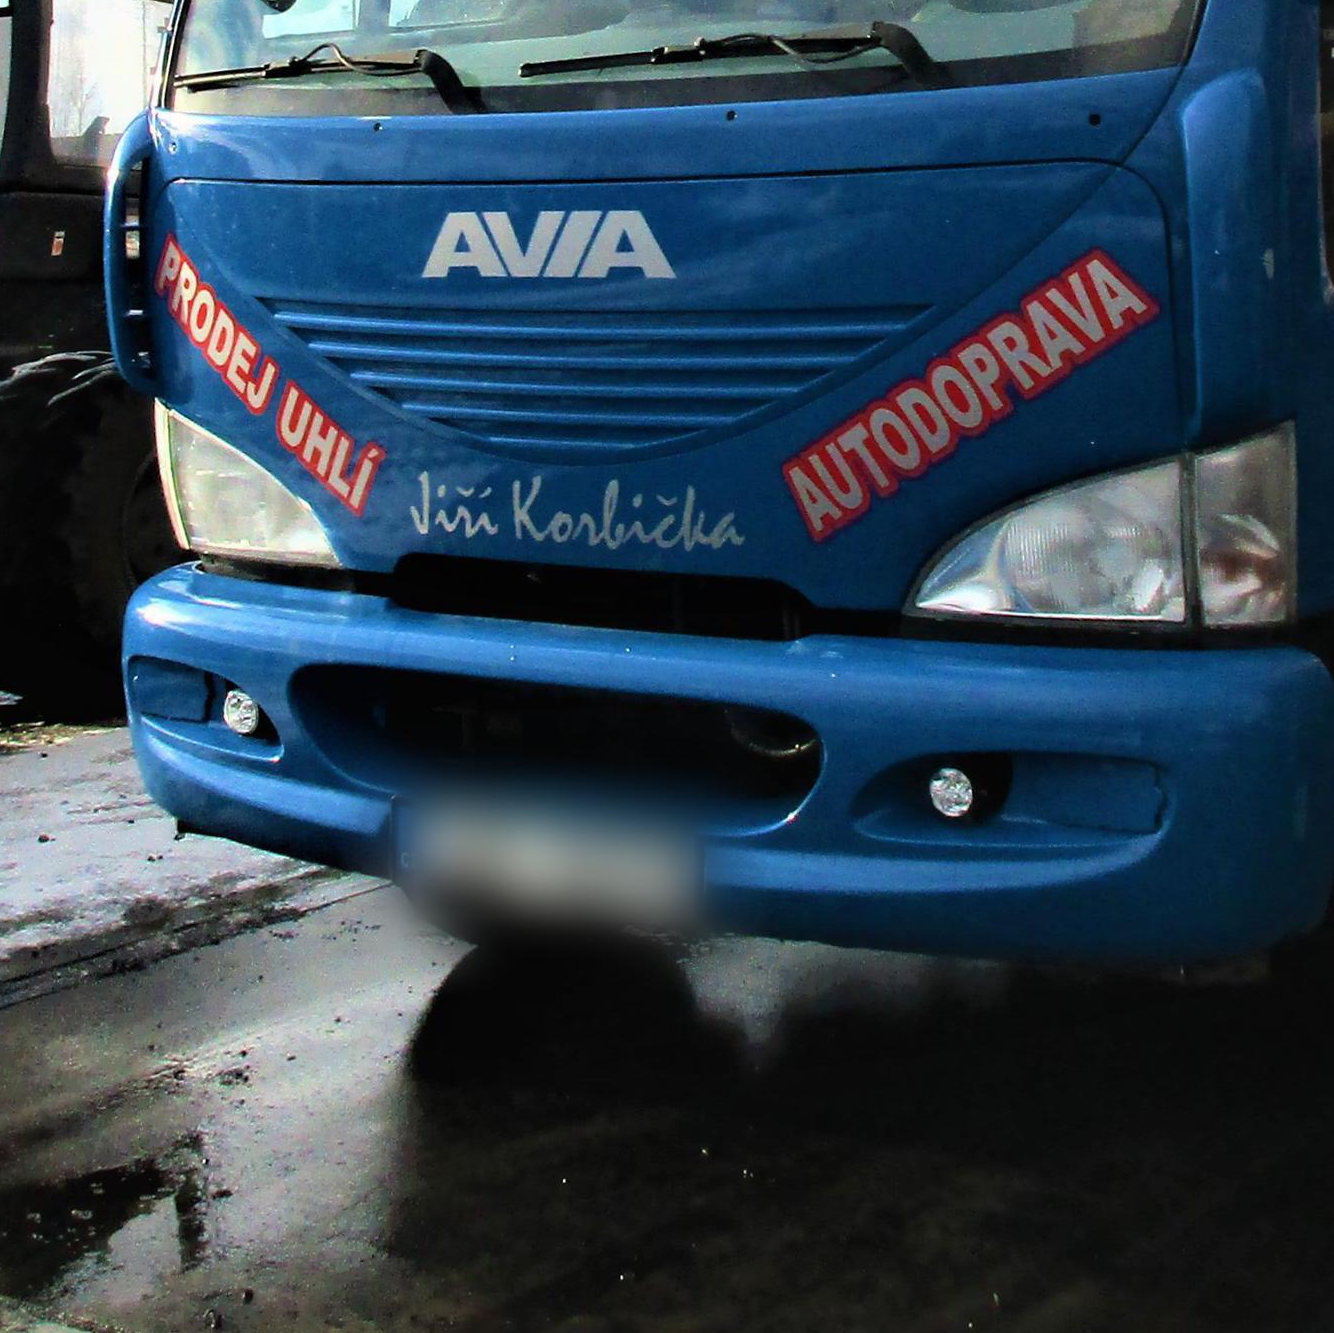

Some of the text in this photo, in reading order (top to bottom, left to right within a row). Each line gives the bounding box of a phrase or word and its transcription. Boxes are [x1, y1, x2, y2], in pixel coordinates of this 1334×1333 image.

[422, 210, 677, 279] AVIA
[162, 241, 384, 511] PRODEJ UHLÍ
[788, 258, 1149, 533] AUTODOPRAVA
[410, 471, 746, 553] Jiří Korbička
